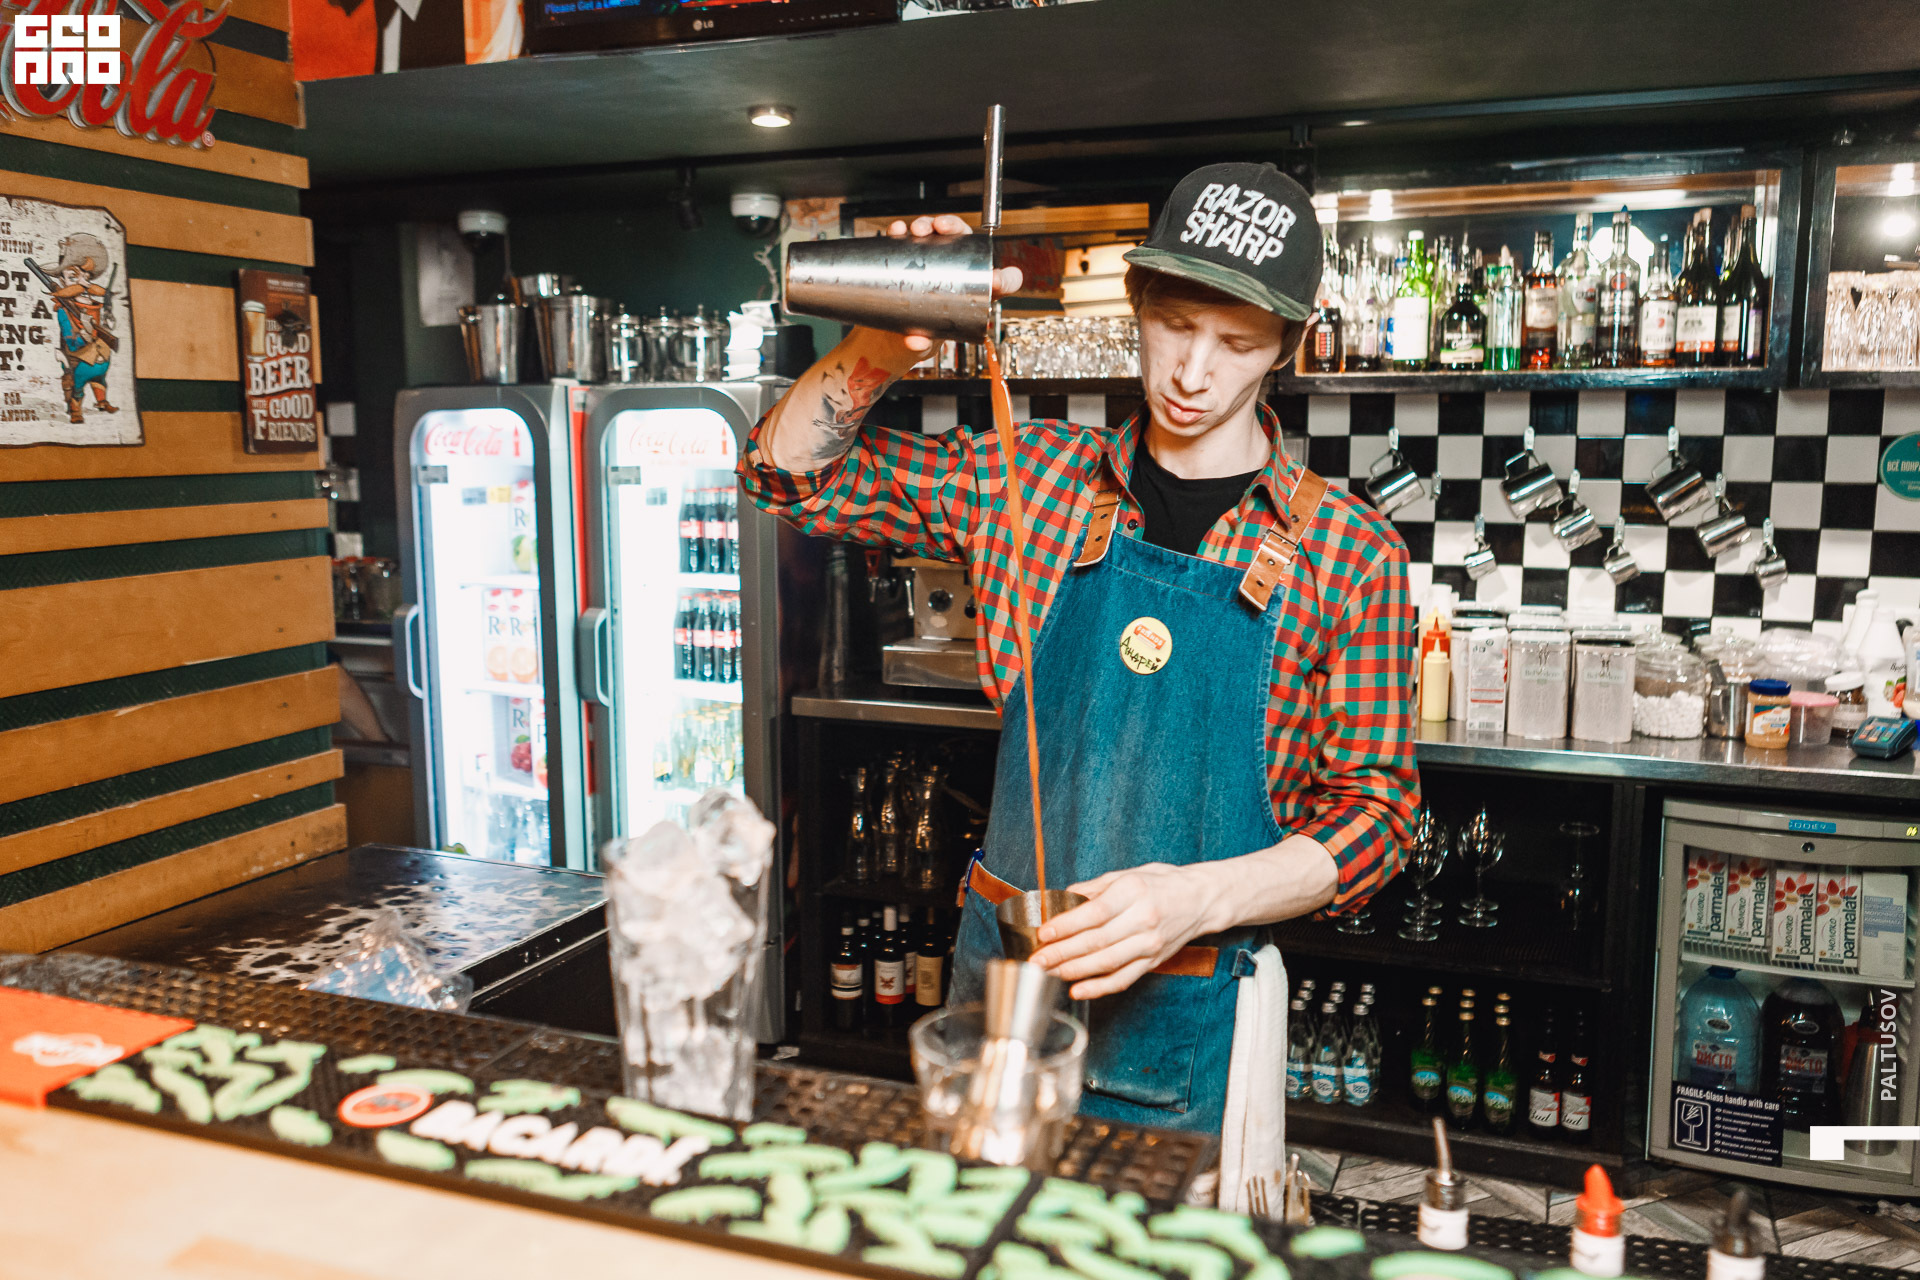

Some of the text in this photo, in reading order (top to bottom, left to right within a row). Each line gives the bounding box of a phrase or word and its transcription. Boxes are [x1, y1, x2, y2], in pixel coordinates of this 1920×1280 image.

[1180, 210, 1284, 265] SHARP
[1193, 183, 1297, 238] RAZOR
[32, 300, 53, 319] A
[248, 355, 312, 396] BEER
[252, 409, 316, 442] FRIENDS
[269, 393, 314, 419] GOOD
[1710, 872, 1725, 931] parmalat
[1751, 876, 1766, 937] parmalat
[1799, 893, 1814, 955] parmalat
[1842, 896, 1858, 959] parmalat
[1724, 1095, 1747, 1106] handle
[1748, 1098, 1763, 1108] with
[1764, 1101, 1780, 1111] care
